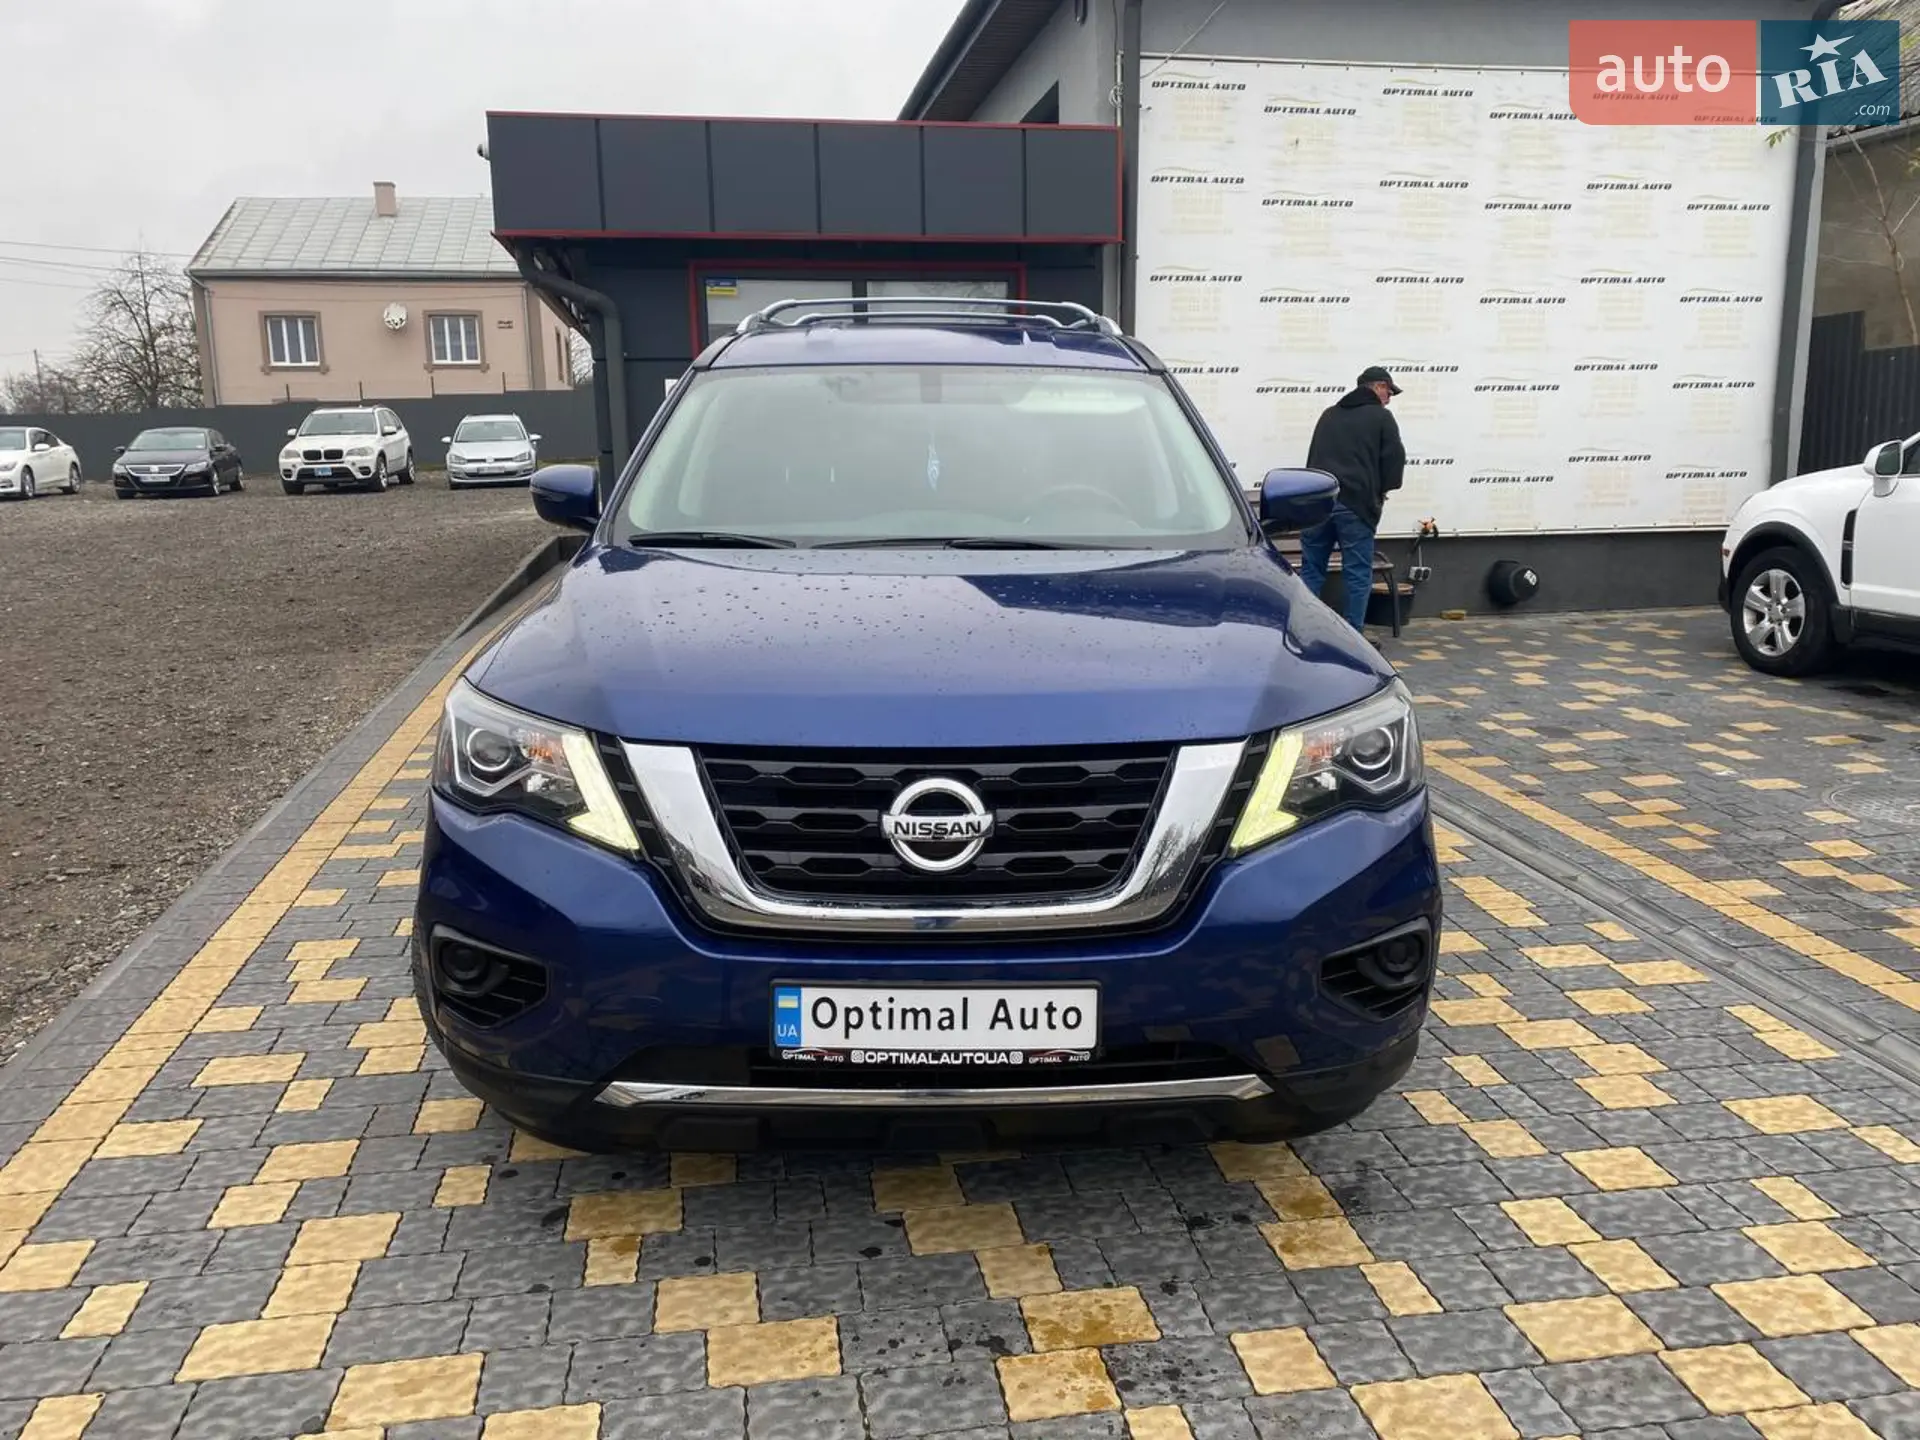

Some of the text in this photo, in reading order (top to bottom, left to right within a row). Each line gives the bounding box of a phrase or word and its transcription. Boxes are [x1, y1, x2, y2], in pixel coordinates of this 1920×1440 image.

[1151, 80, 1247, 91] OPTIMAL AUTO
[1382, 87, 1474, 98] OPTIMAL AUTO
[1263, 105, 1357, 116] OPTIMAL AUTO
[1488, 111, 1577, 121] OPTIMAL AUTO
[1149, 175, 1245, 185] OPTIMAL AUTO
[1379, 179, 1470, 189] OPTIMAL AUTO
[1585, 182, 1673, 191] OPTIMAL AUTO
[1261, 198, 1354, 208] OPTIMAL AUTO
[1484, 202, 1573, 211] OPTIMAL AUTO
[1686, 203, 1771, 211] OPTIMAL AUTO
[1149, 274, 1243, 283] OPTIMAL AUTO
[1375, 276, 1465, 285] OPTIMAL AUTO
[1580, 276, 1666, 285] OPTIMAL AUTO
[1259, 295, 1351, 304] OPTIMAL AUTO
[1479, 296, 1567, 305] OPTIMAL AUTO
[1679, 295, 1764, 304] OPTIMAL AUTO
[1206, 366, 1240, 374] AUTO
[1426, 365, 1460, 373] AUTO
[1573, 363, 1659, 372] OPTIMAL AUTO
[1255, 385, 1347, 394] OPTIMAL AUTO
[1473, 384, 1561, 393] OPTIMAL AUTO
[1671, 381, 1756, 390] OPTIMAL AUTO
[1423, 458, 1455, 466] AUTO
[1567, 454, 1652, 463] OPTIMAL AUTO
[1468, 475, 1555, 484] OPTIMAL AUTO
[1665, 470, 1748, 480] OPTIMAL AUTO
[893, 820, 981, 836] NISSAN
[811, 996, 1083, 1040] Optimal Auto
[777, 1024, 798, 1038] UA
[782, 1050, 816, 1061] OPTIMAL
[1028, 1051, 1091, 1063] OPTIMAL AUTO
